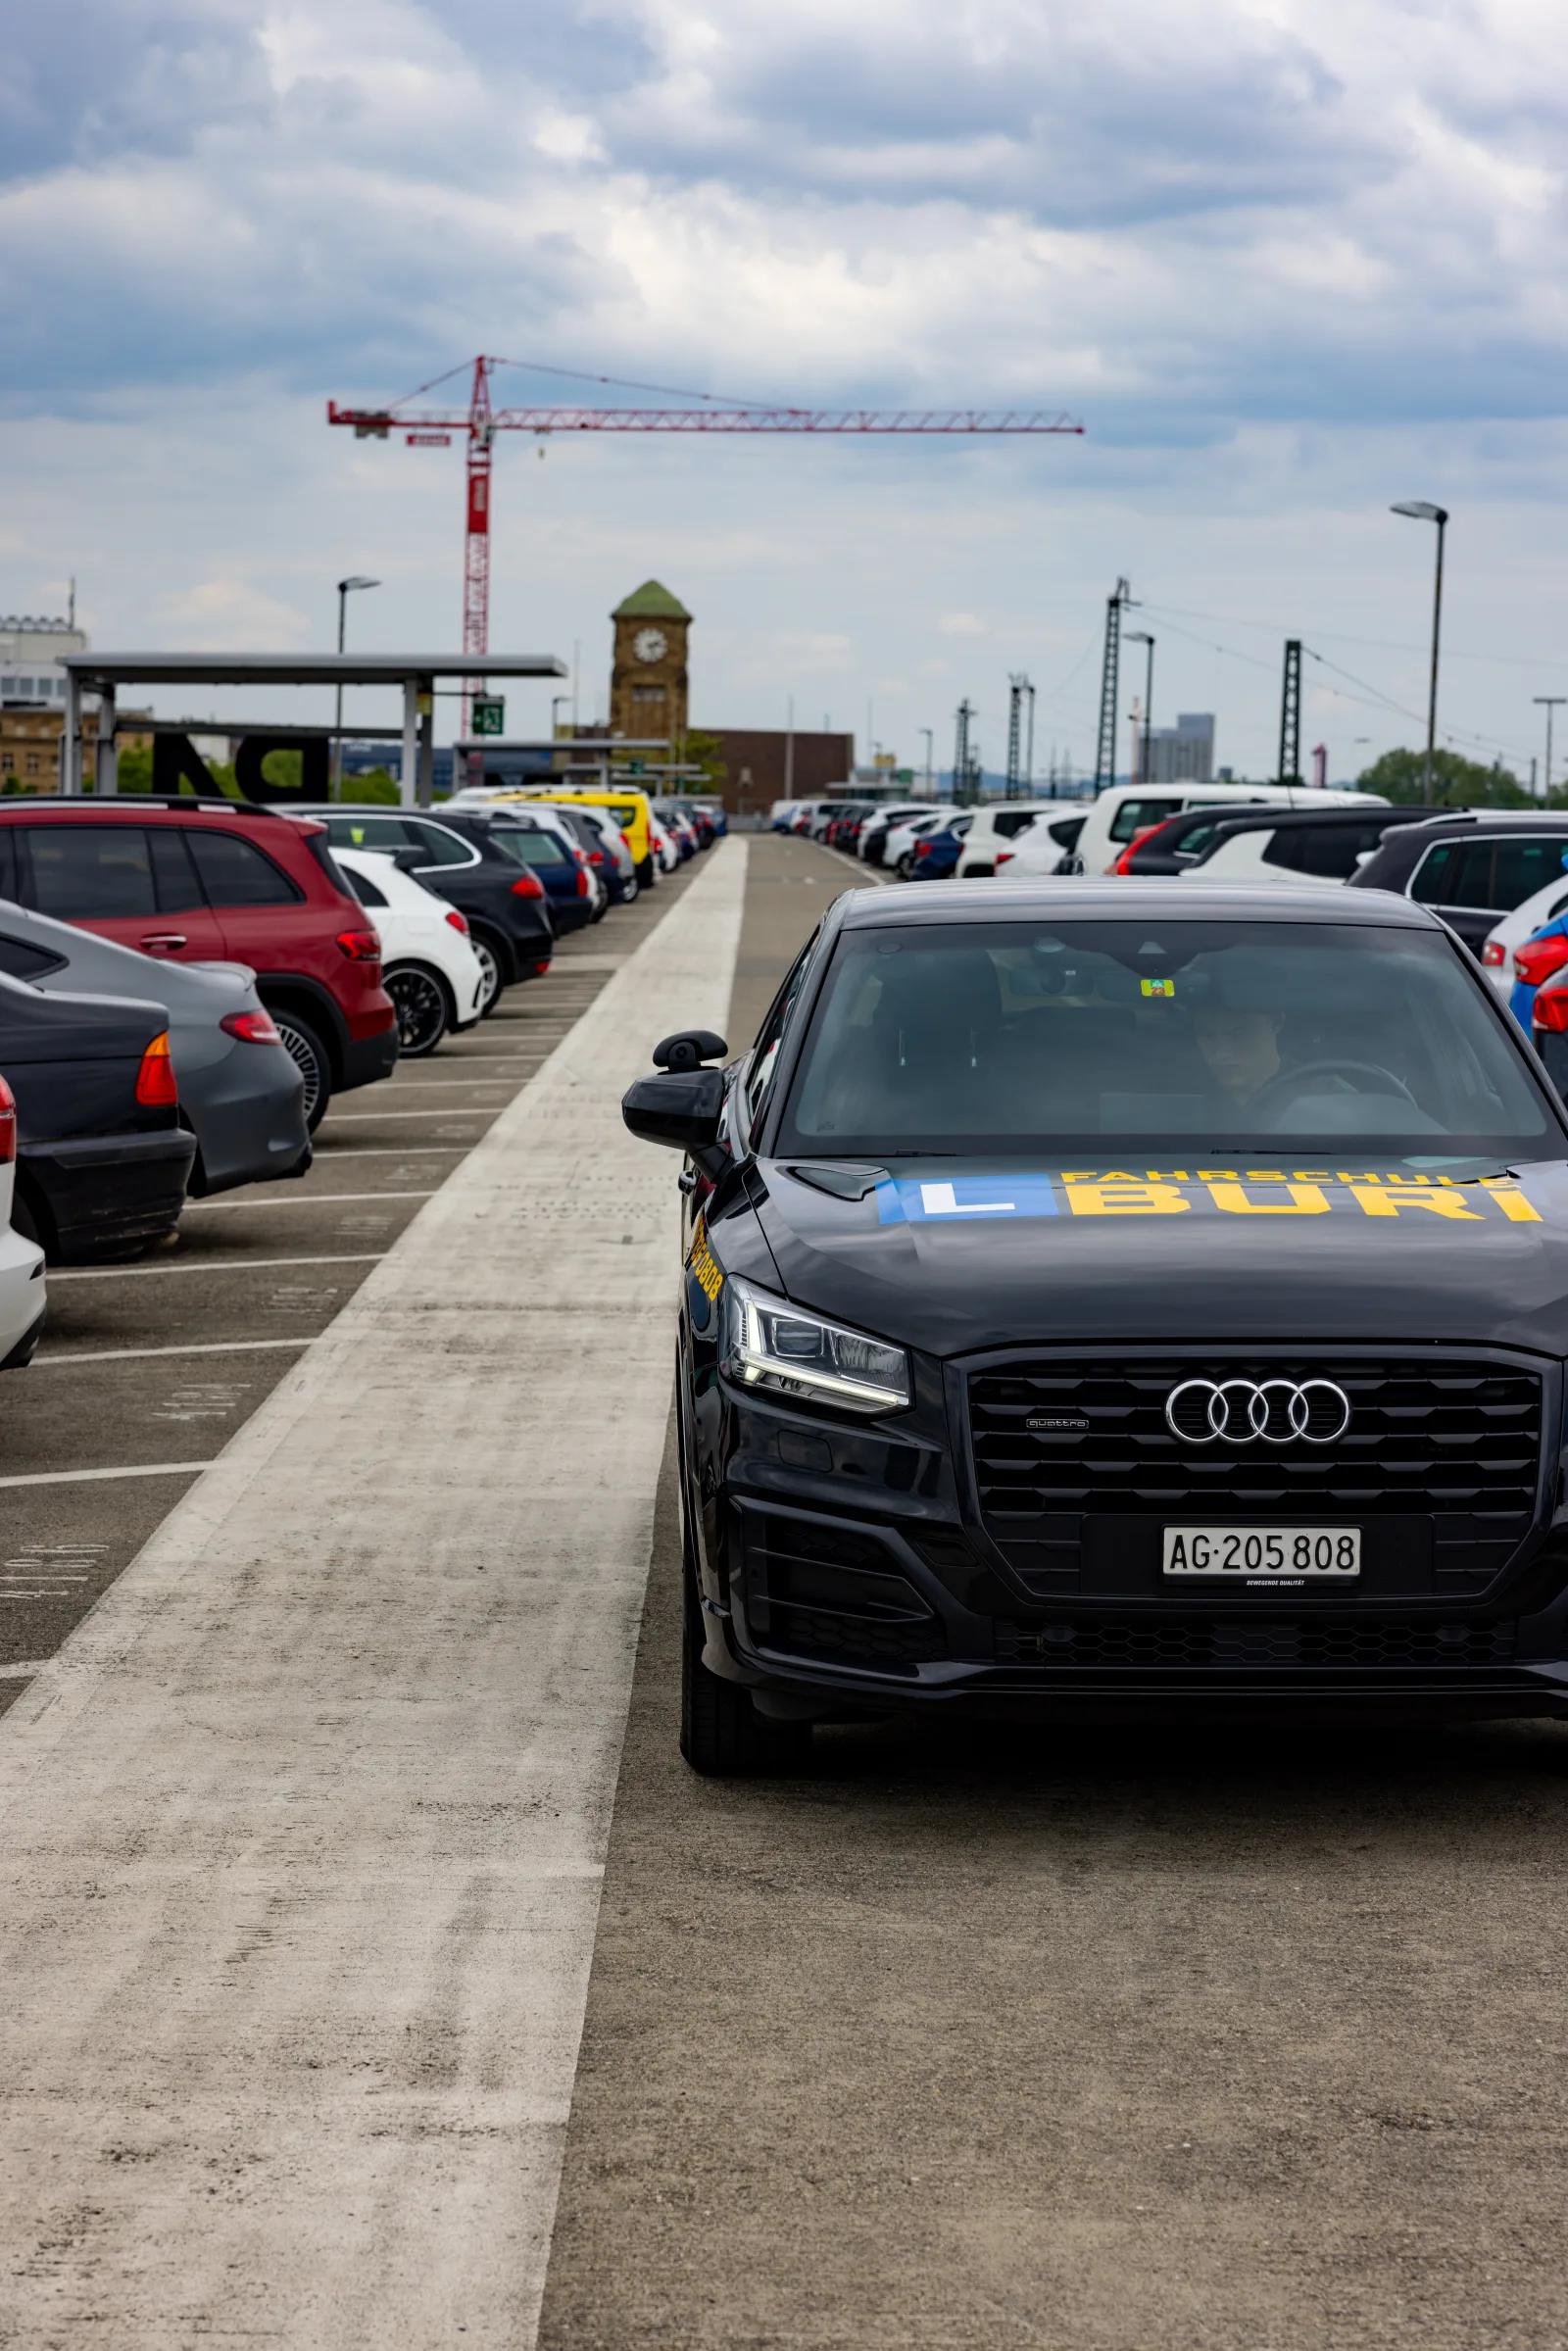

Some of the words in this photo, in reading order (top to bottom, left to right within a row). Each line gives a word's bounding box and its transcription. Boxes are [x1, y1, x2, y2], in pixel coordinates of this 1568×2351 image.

[1060, 1170, 1522, 1188] FAHRSCHULE
[920, 1183, 1015, 1214] L
[1065, 1184, 1544, 1222] BURI
